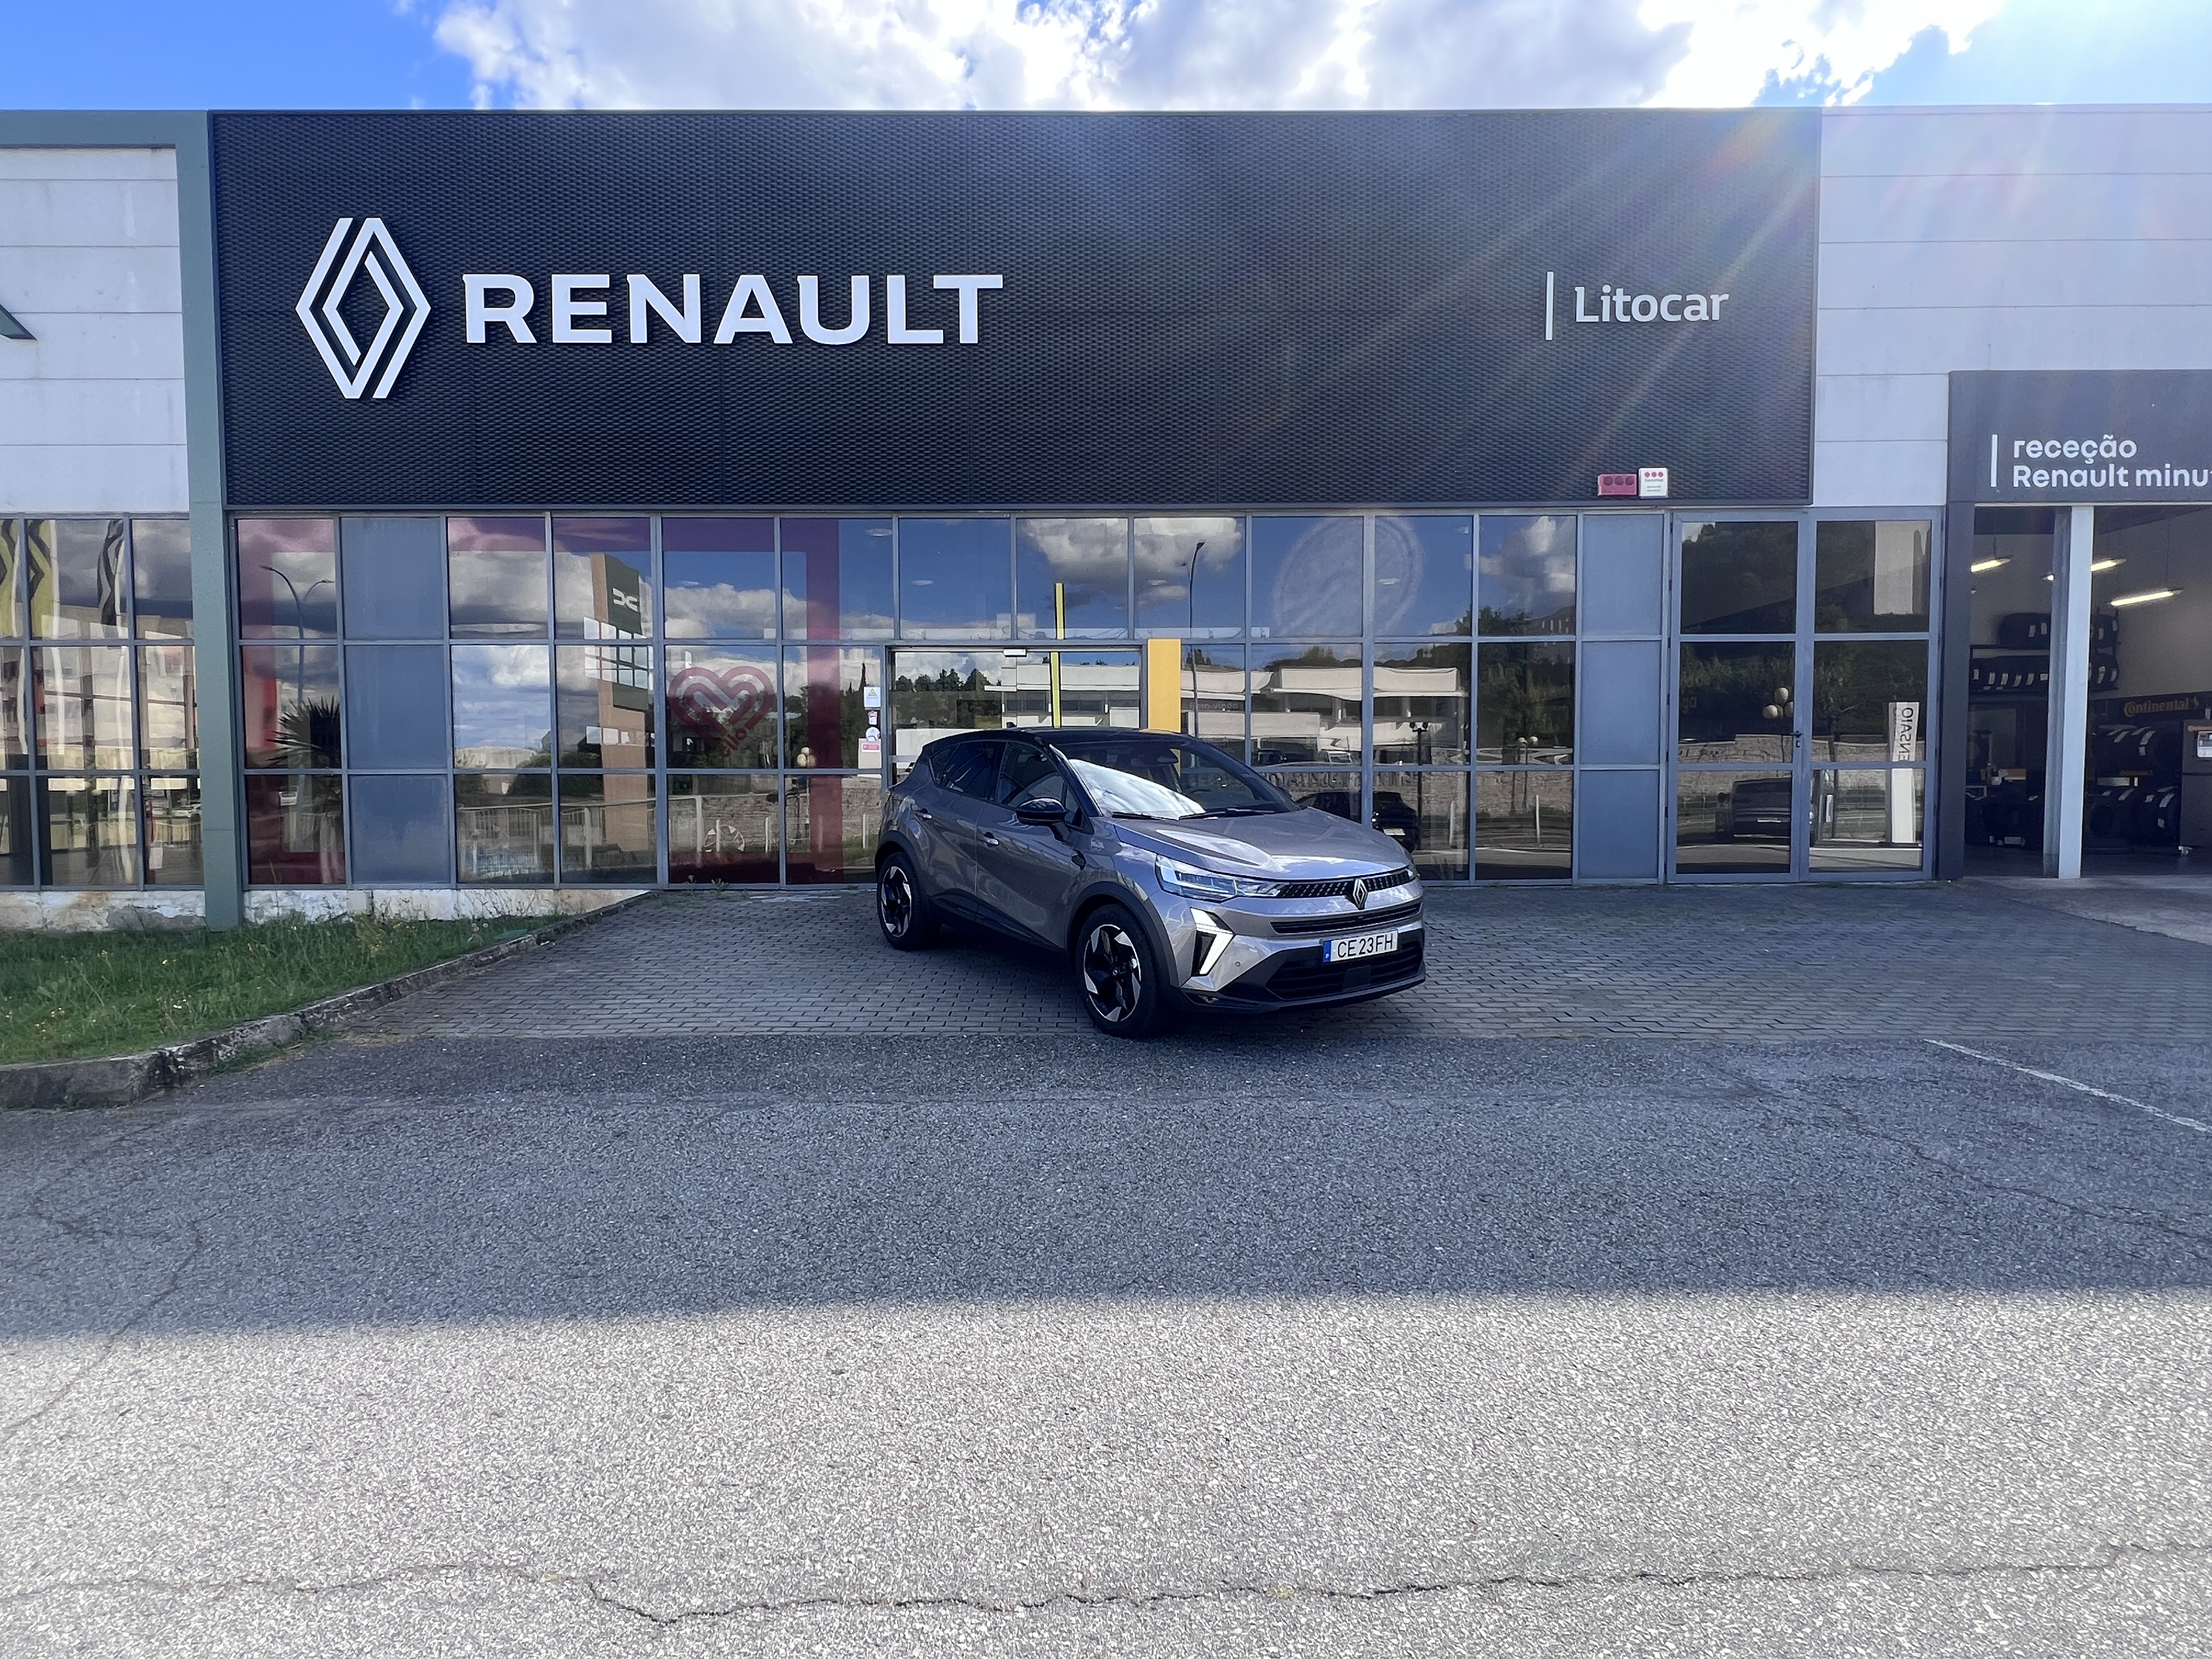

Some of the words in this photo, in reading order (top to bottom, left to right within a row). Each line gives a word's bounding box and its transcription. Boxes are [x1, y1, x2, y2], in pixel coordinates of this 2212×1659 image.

[462, 274, 1003, 345] RENAULT
[1575, 284, 1730, 323] Litocar
[2013, 434, 2137, 464] receção
[2013, 463, 2129, 488] Renault
[2135, 463, 2212, 488] minu
